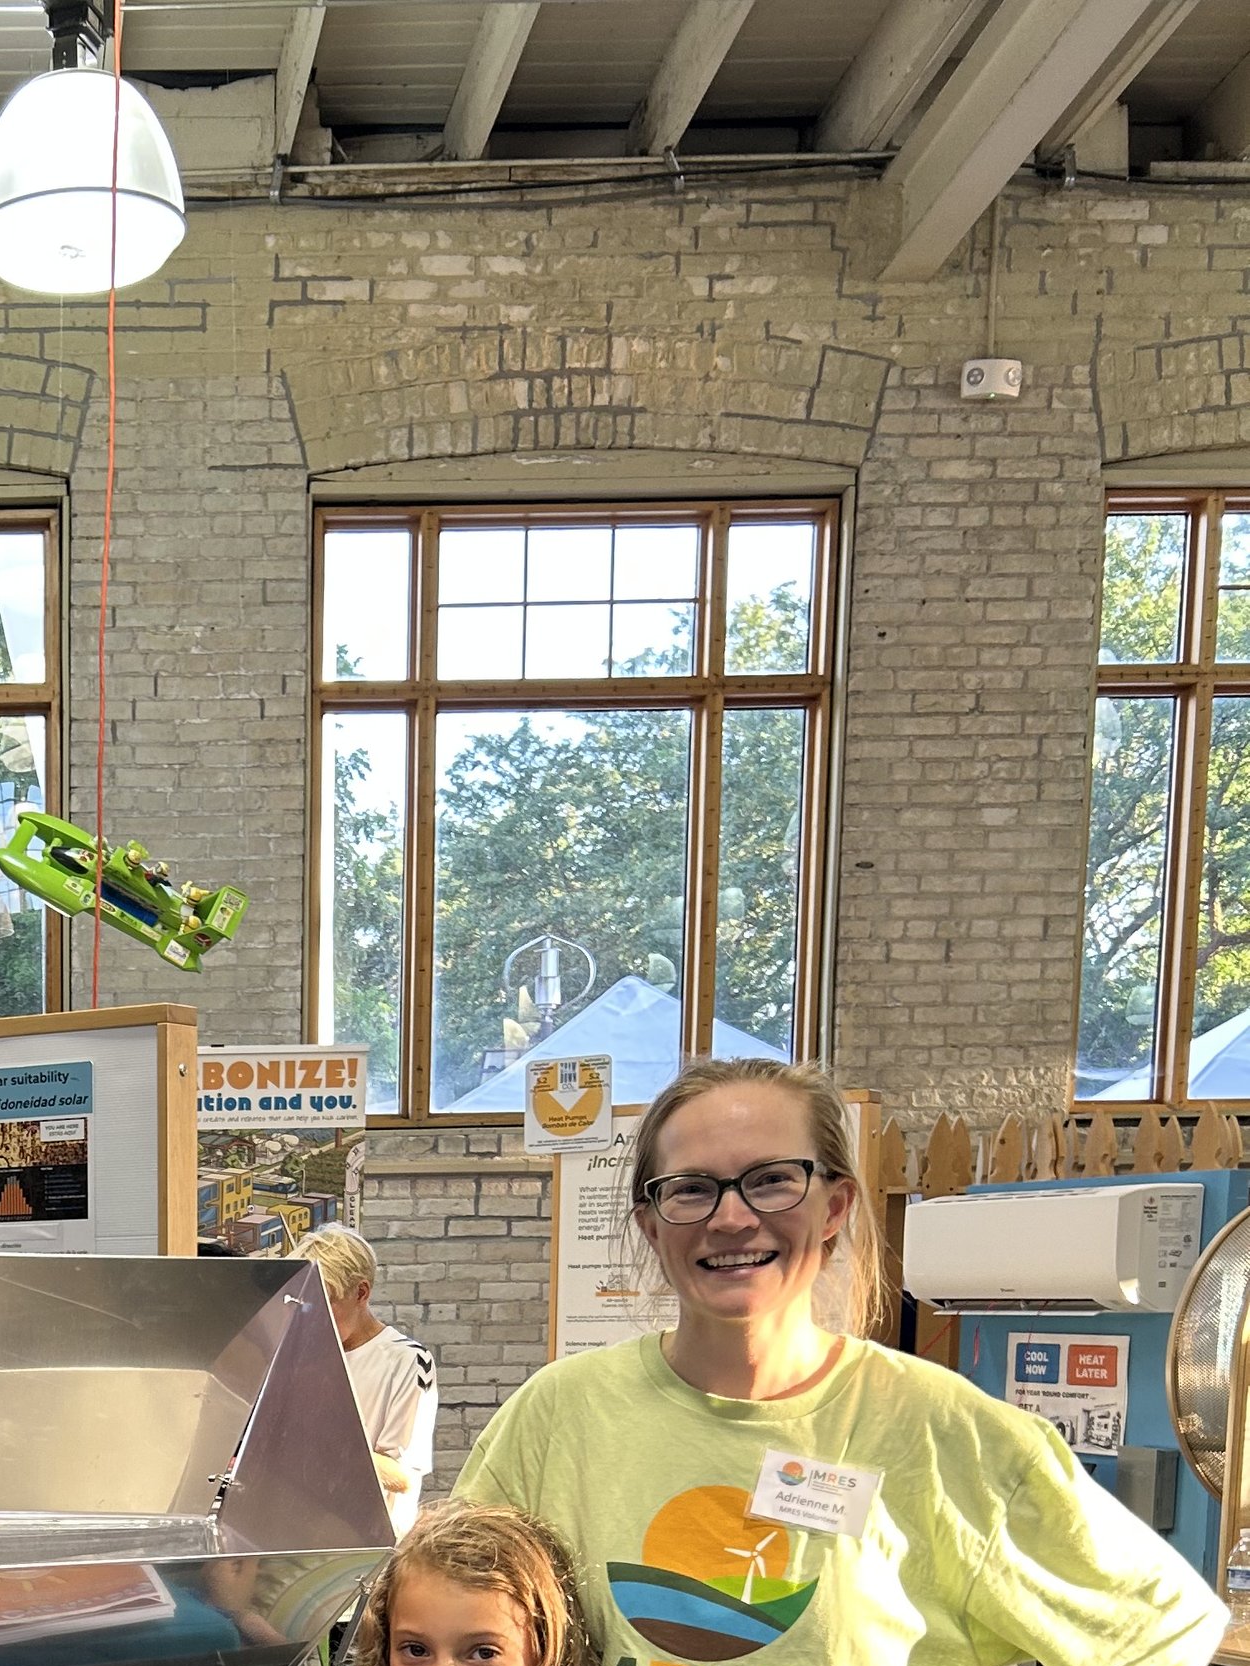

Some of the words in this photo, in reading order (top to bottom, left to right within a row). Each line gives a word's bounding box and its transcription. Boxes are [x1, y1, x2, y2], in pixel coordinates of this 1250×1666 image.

[11, 1071, 69, 1085] suitability
[197, 1058, 358, 1090] BONIZE!
[58, 1094, 89, 1106] solar
[259, 1093, 302, 1111] and
[310, 1095, 357, 1112] you.
[1024, 1351, 1049, 1362] COOL
[1079, 1354, 1105, 1366] HEAT
[1025, 1364, 1047, 1375] NOW
[1075, 1368, 1108, 1379] LATER
[1062, 1391, 1089, 1399] COMFORT
[813, 1470, 857, 1488] MRES
[775, 1491, 829, 1511] Adrienne
[832, 1503, 847, 1516] M.
